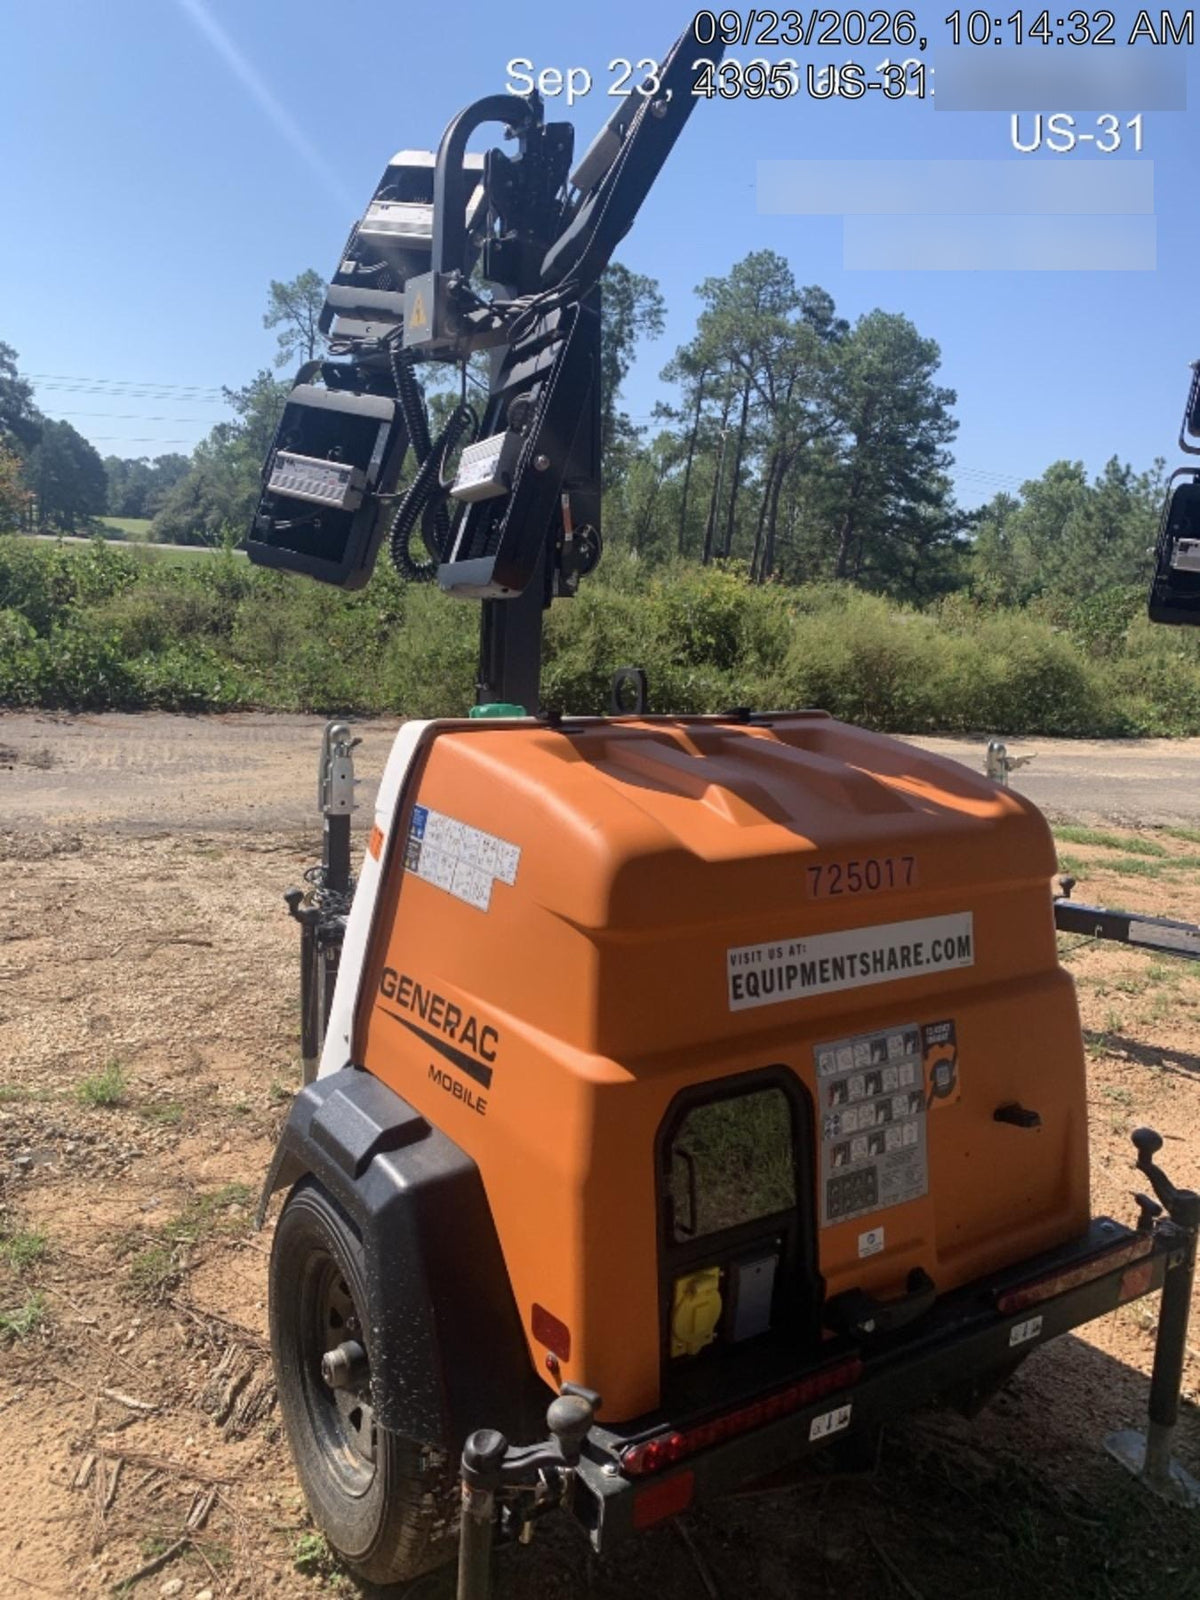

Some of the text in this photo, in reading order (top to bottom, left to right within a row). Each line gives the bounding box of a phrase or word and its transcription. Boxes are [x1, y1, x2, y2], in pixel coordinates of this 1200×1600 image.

[807, 856, 915, 897] 725017
[730, 943, 807, 966] VISIT US AT:
[732, 934, 972, 1000] EQUIPMENTSHARE.COM
[380, 966, 498, 1062] GENERAC
[428, 1063, 488, 1116] MOBILE
